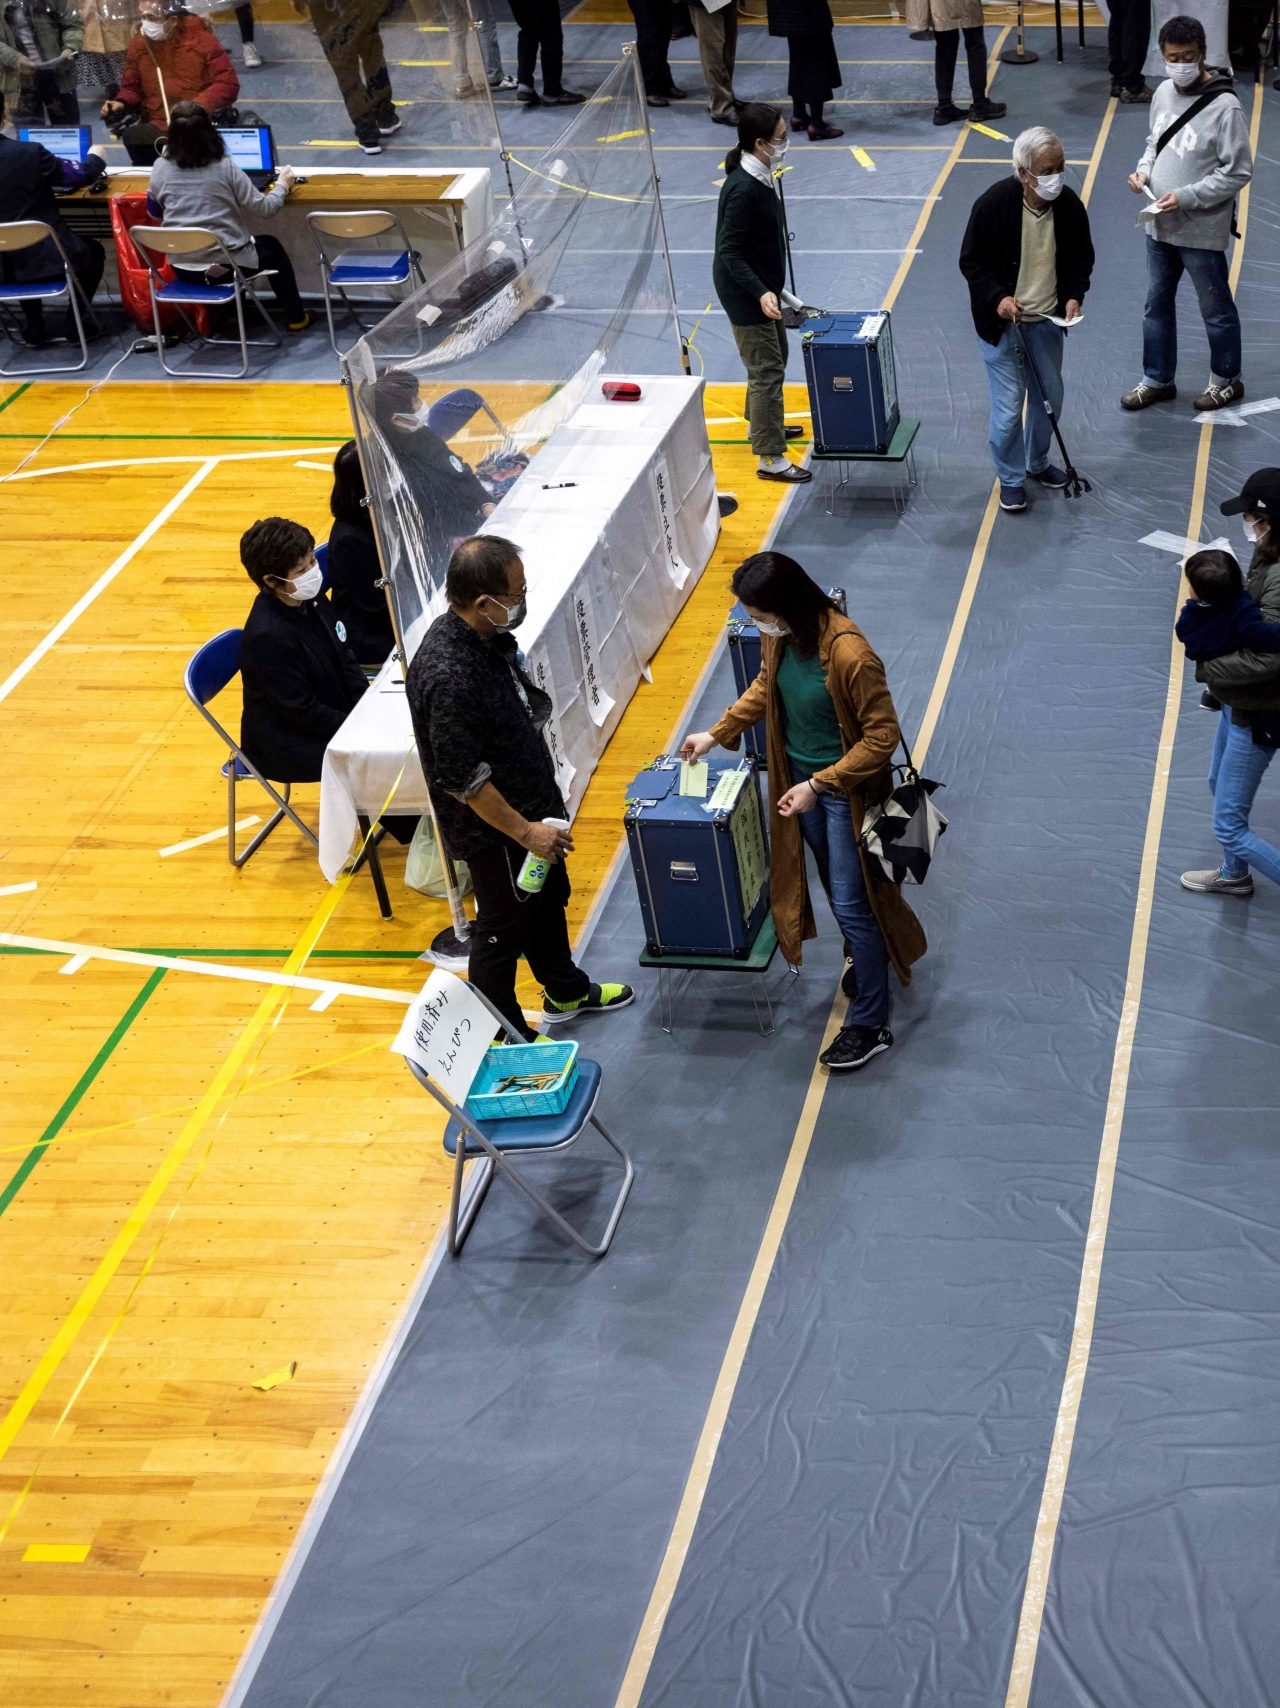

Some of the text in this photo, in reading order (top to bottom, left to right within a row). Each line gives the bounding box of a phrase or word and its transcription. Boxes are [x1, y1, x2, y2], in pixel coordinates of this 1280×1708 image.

[413, 990, 448, 1053] 使用済み
[438, 1018, 471, 1077] えんぴつ
